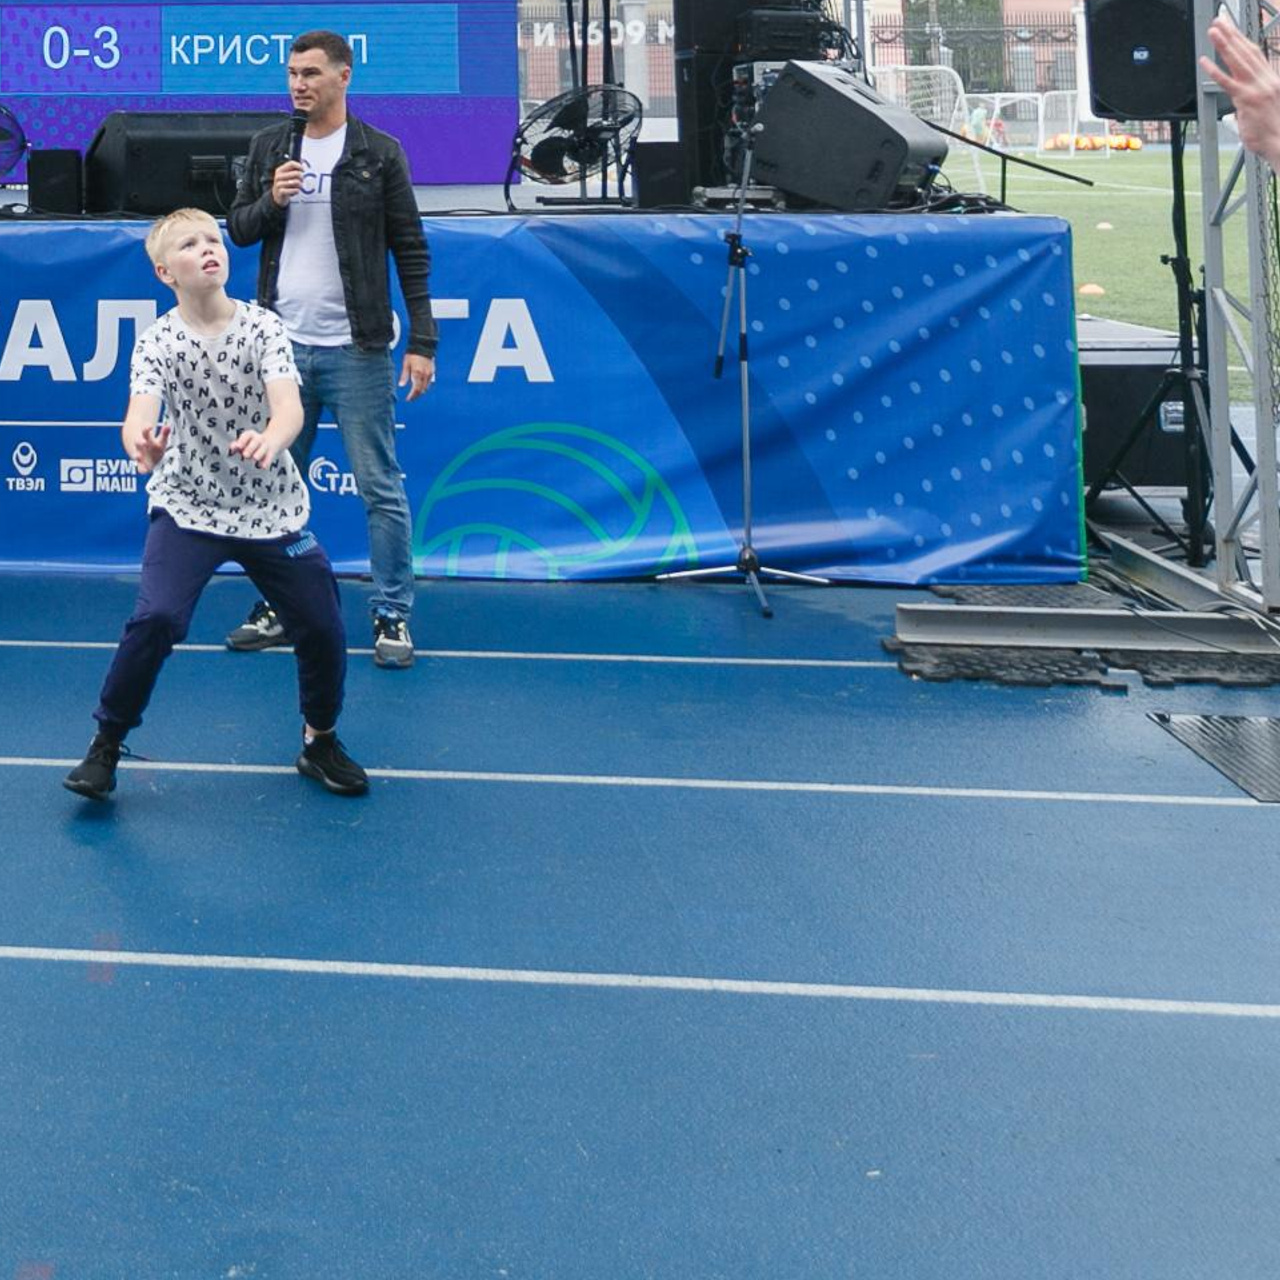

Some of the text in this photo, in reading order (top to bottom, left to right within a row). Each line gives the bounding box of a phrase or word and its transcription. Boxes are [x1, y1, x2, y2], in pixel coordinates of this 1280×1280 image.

[42, 24, 120, 70] 0-3
[170, 33, 368, 65] КРИСТЛ
[6, 477, 46, 492] ТВЭЛ
[96, 476, 138, 493] МАШ
